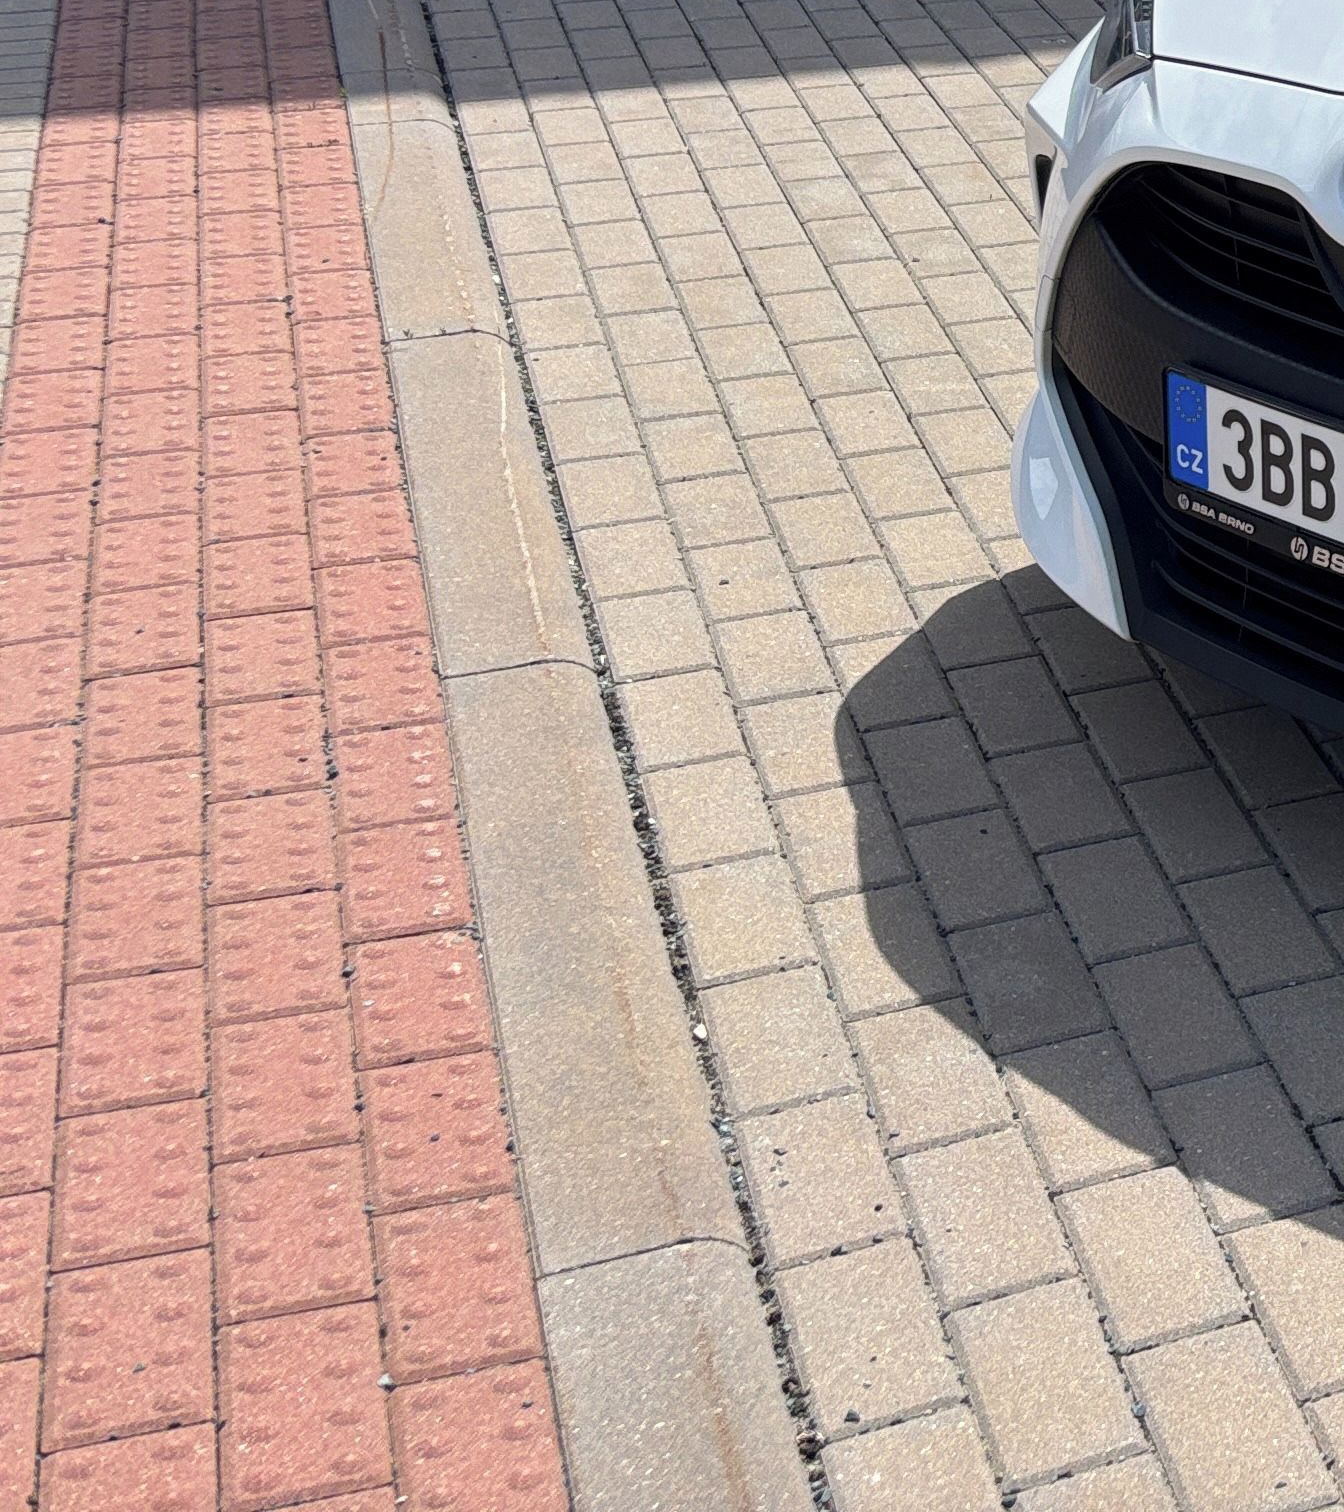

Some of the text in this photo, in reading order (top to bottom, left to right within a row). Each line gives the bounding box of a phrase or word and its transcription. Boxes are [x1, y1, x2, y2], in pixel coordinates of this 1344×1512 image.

[1176, 443, 1204, 475] CZ
[1221, 409, 1336, 522] 3BB
[1191, 500, 1254, 535] BSA BRNO
